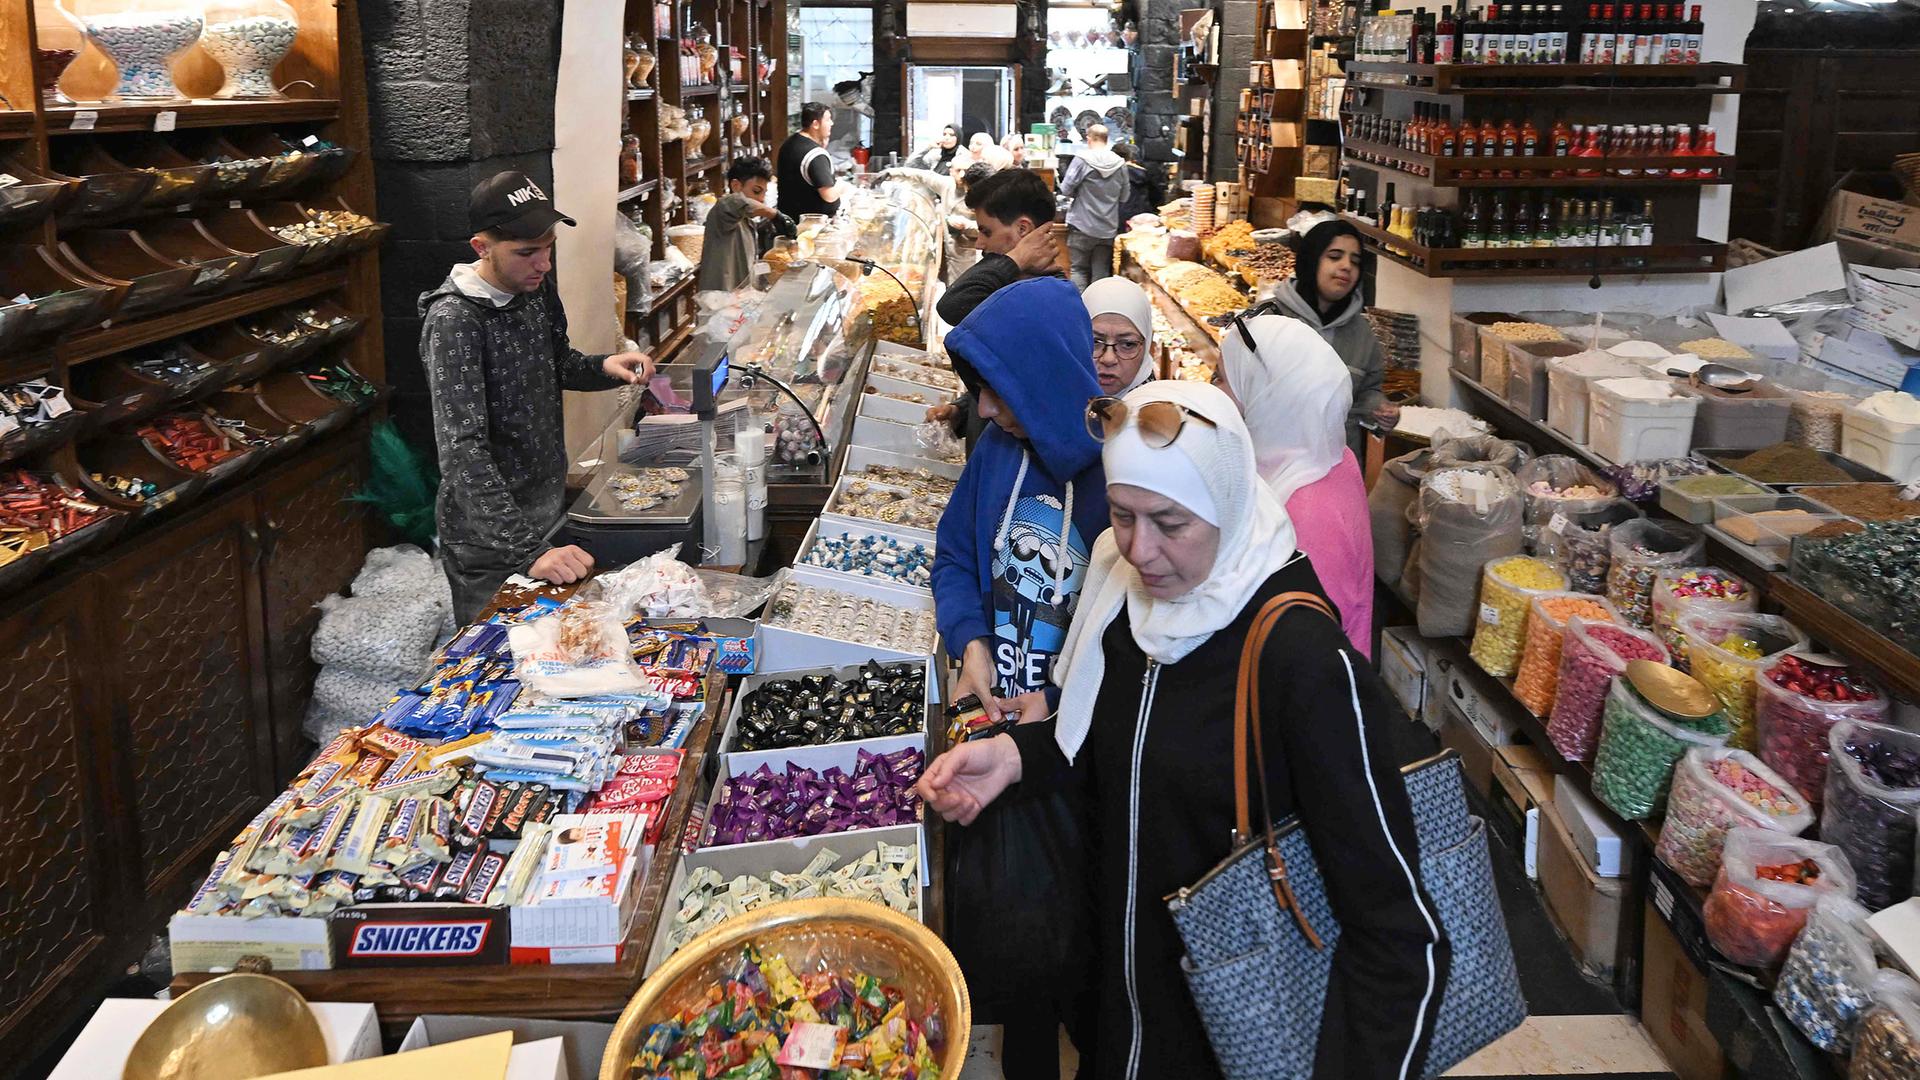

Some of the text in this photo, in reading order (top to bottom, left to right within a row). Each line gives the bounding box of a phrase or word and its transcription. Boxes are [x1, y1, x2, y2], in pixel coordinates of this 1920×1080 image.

[507, 184, 547, 207] NIKE
[467, 857, 499, 900] SNICKERS
[357, 925, 482, 952] SNICKERS
